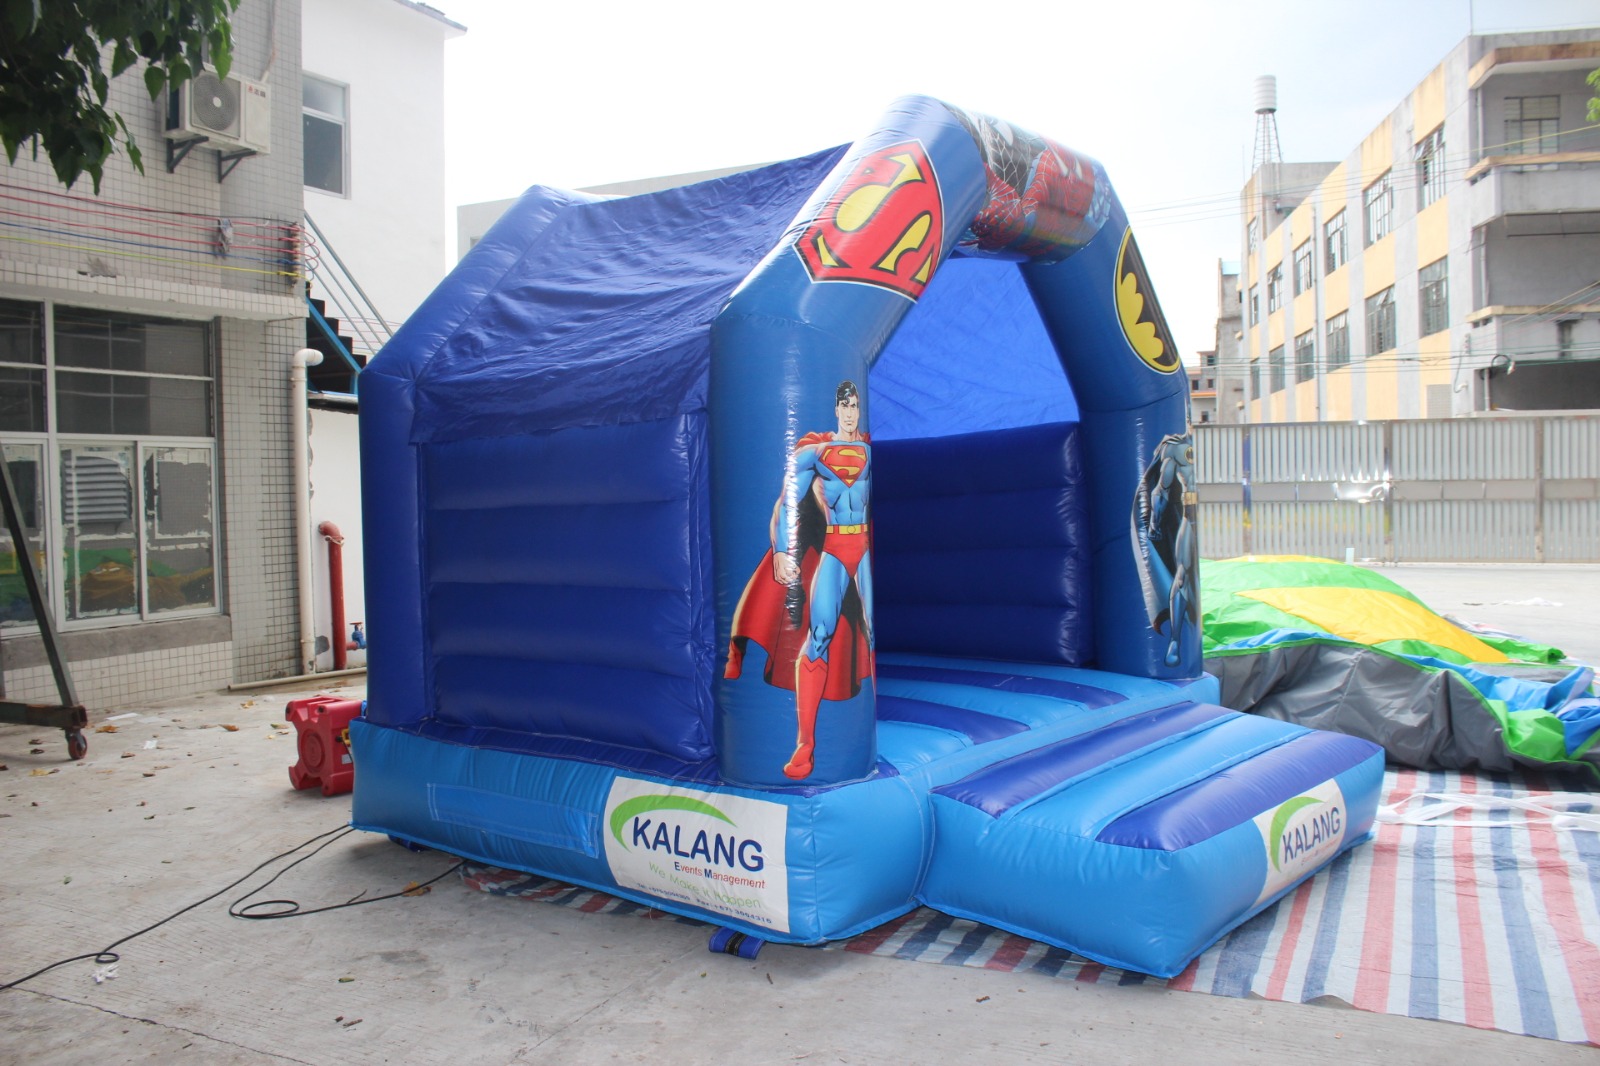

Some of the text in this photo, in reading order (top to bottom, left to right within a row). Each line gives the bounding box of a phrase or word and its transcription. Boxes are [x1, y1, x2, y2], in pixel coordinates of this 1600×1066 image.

[633, 816, 764, 872] KALANG
[1282, 806, 1340, 864] KALANG
[649, 860, 665, 878] We
[670, 873, 699, 895] Make
[674, 861, 766, 889] Events Management
